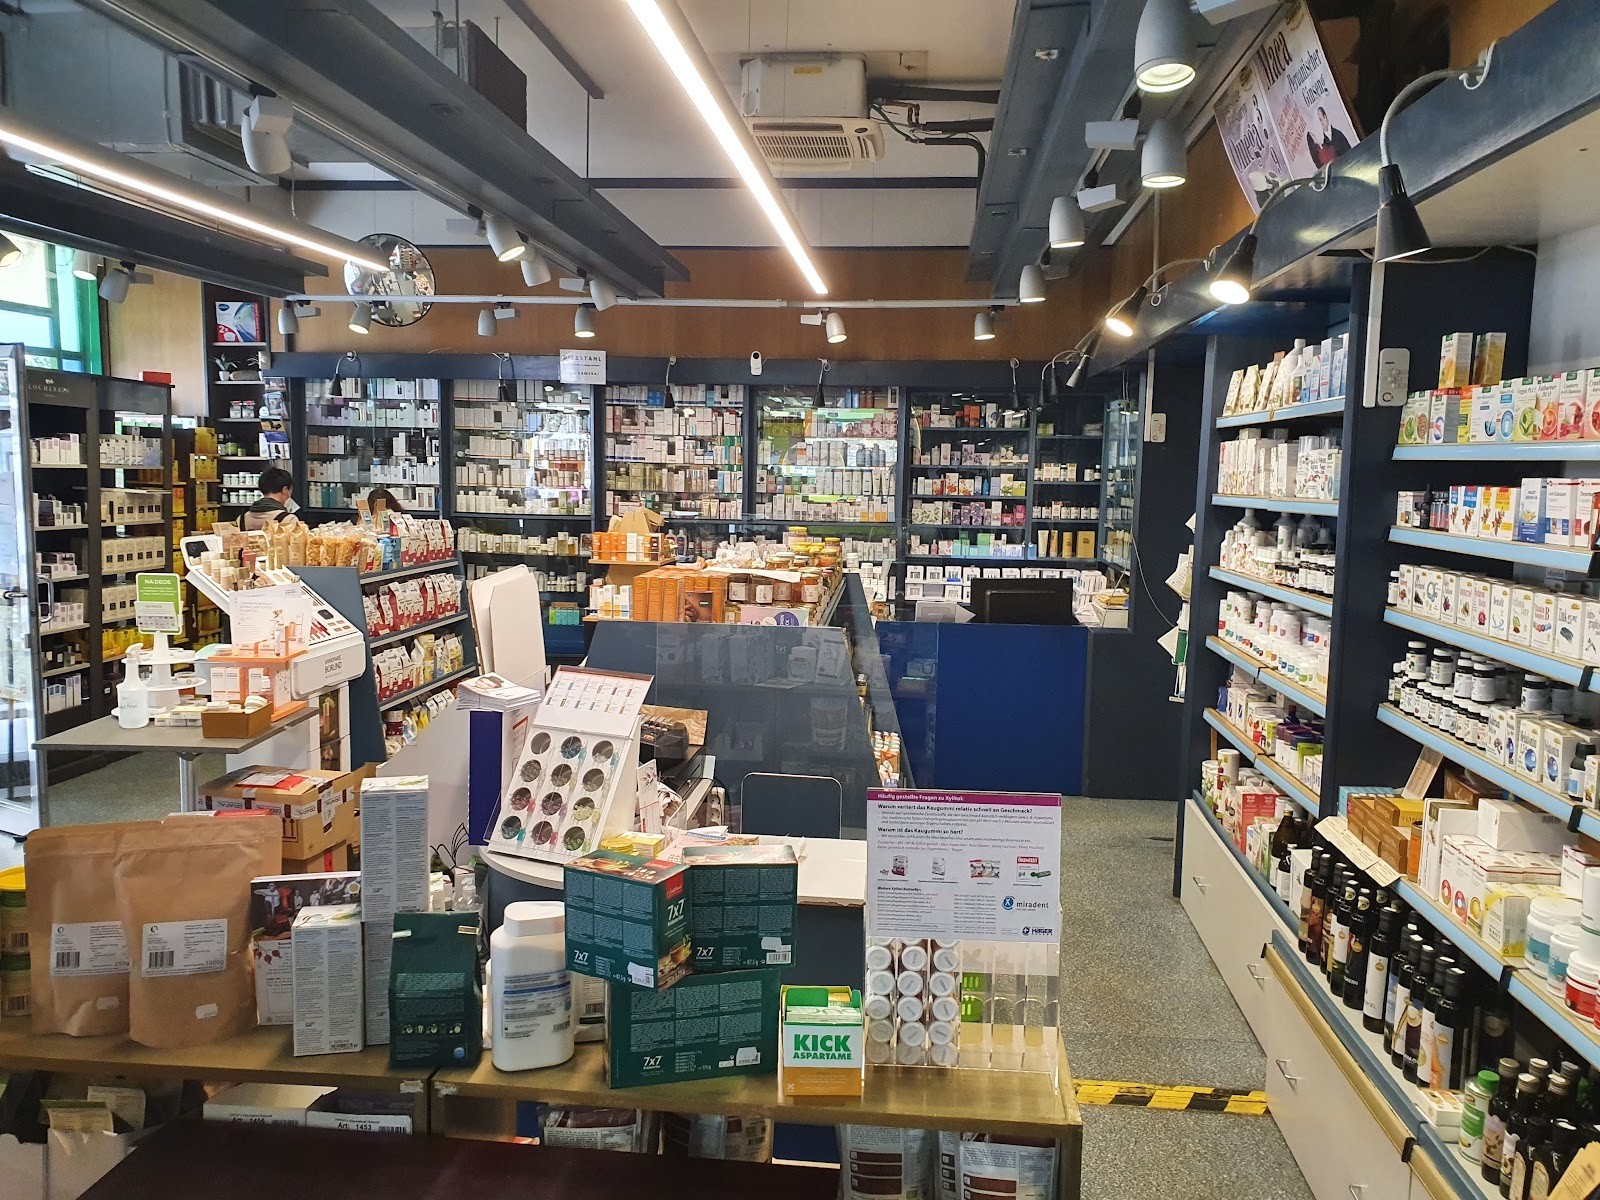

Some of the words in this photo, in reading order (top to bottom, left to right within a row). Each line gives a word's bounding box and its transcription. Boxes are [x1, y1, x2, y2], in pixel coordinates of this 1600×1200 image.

[1228, 122, 1265, 174] Omega
[667, 897, 686, 921] 7x7
[1016, 900, 1050, 909] miradent
[573, 949, 589, 962] 7x7
[696, 946, 715, 957] 7x7
[793, 1033, 852, 1053] KICK
[643, 1055, 663, 1067] 7x7
[792, 1051, 852, 1061] ASPARTAME
[337, 1122, 351, 1130] Art:
[355, 1123, 372, 1131] 1453
